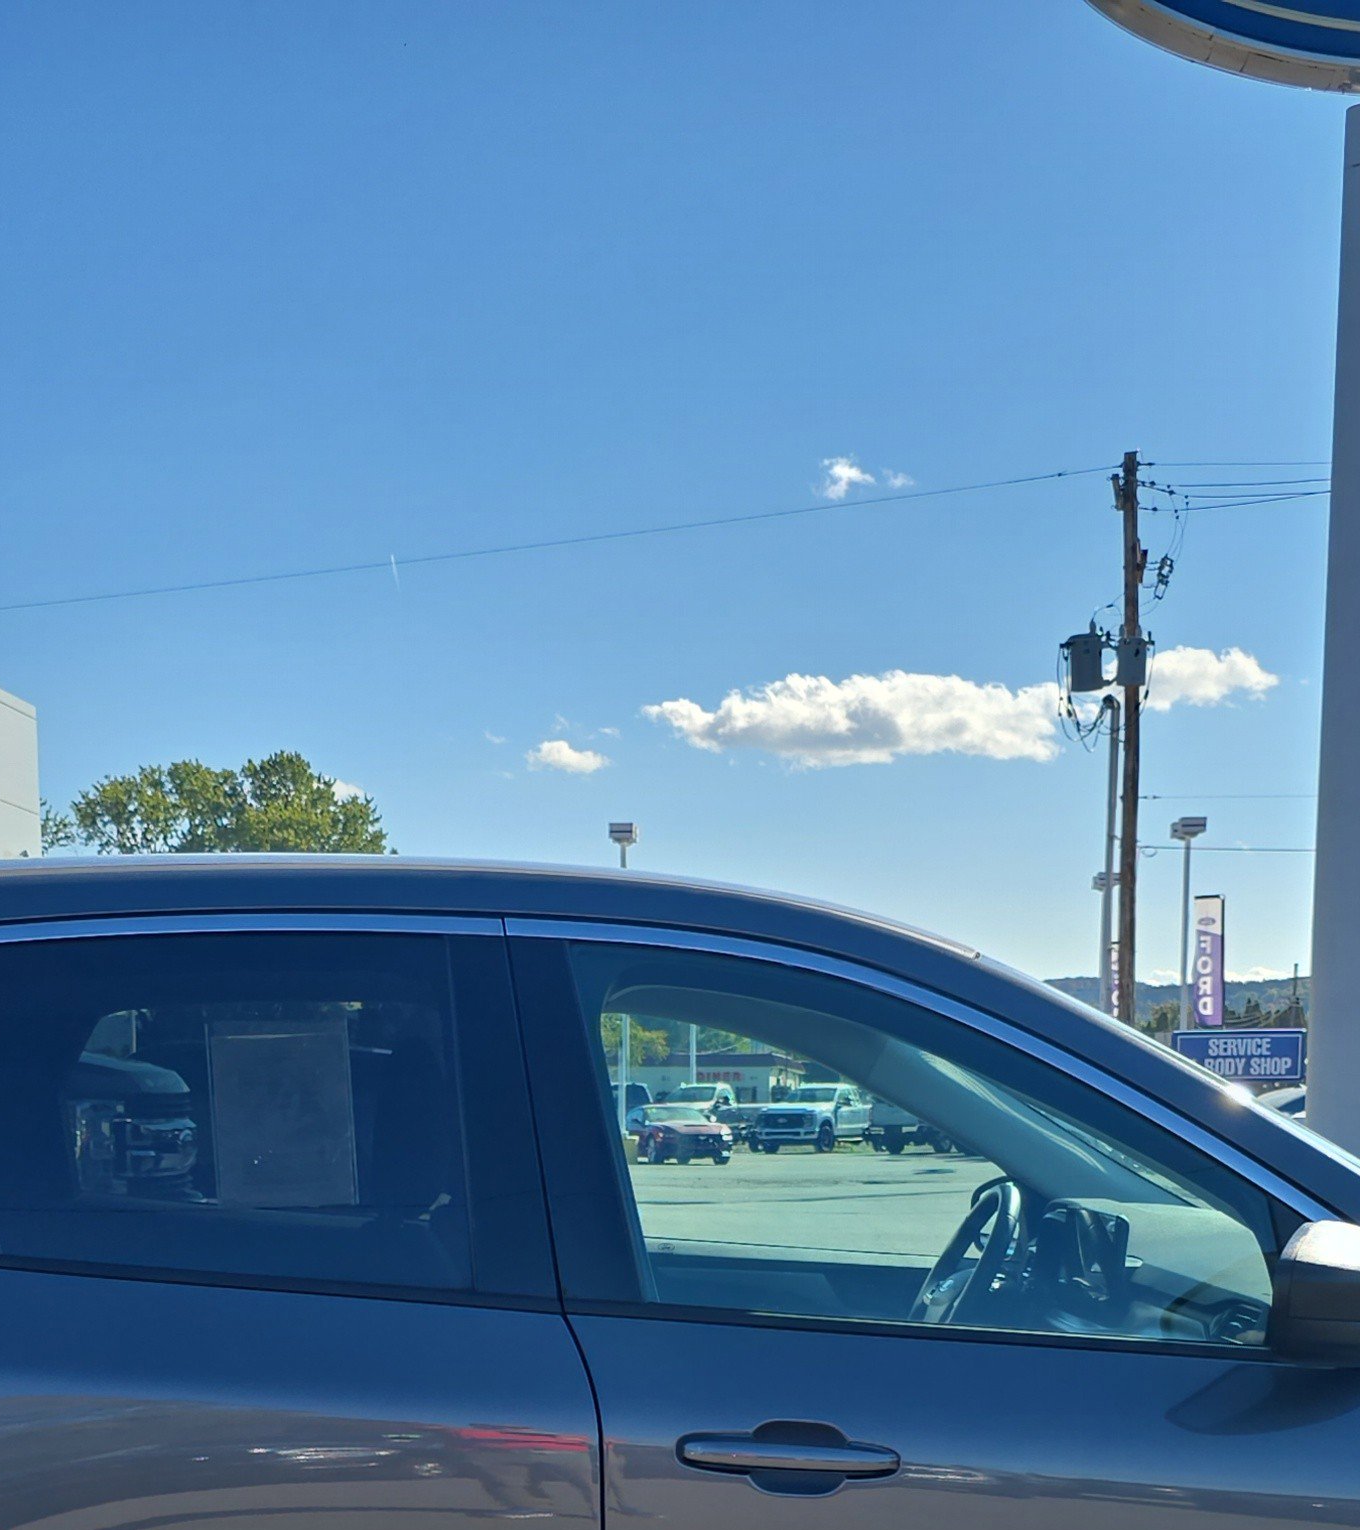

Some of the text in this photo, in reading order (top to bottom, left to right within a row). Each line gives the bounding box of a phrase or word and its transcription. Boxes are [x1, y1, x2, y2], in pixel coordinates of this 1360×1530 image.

[1208, 1038, 1271, 1056] SERVICE
[1204, 1056, 1291, 1075] BODY SHOP
